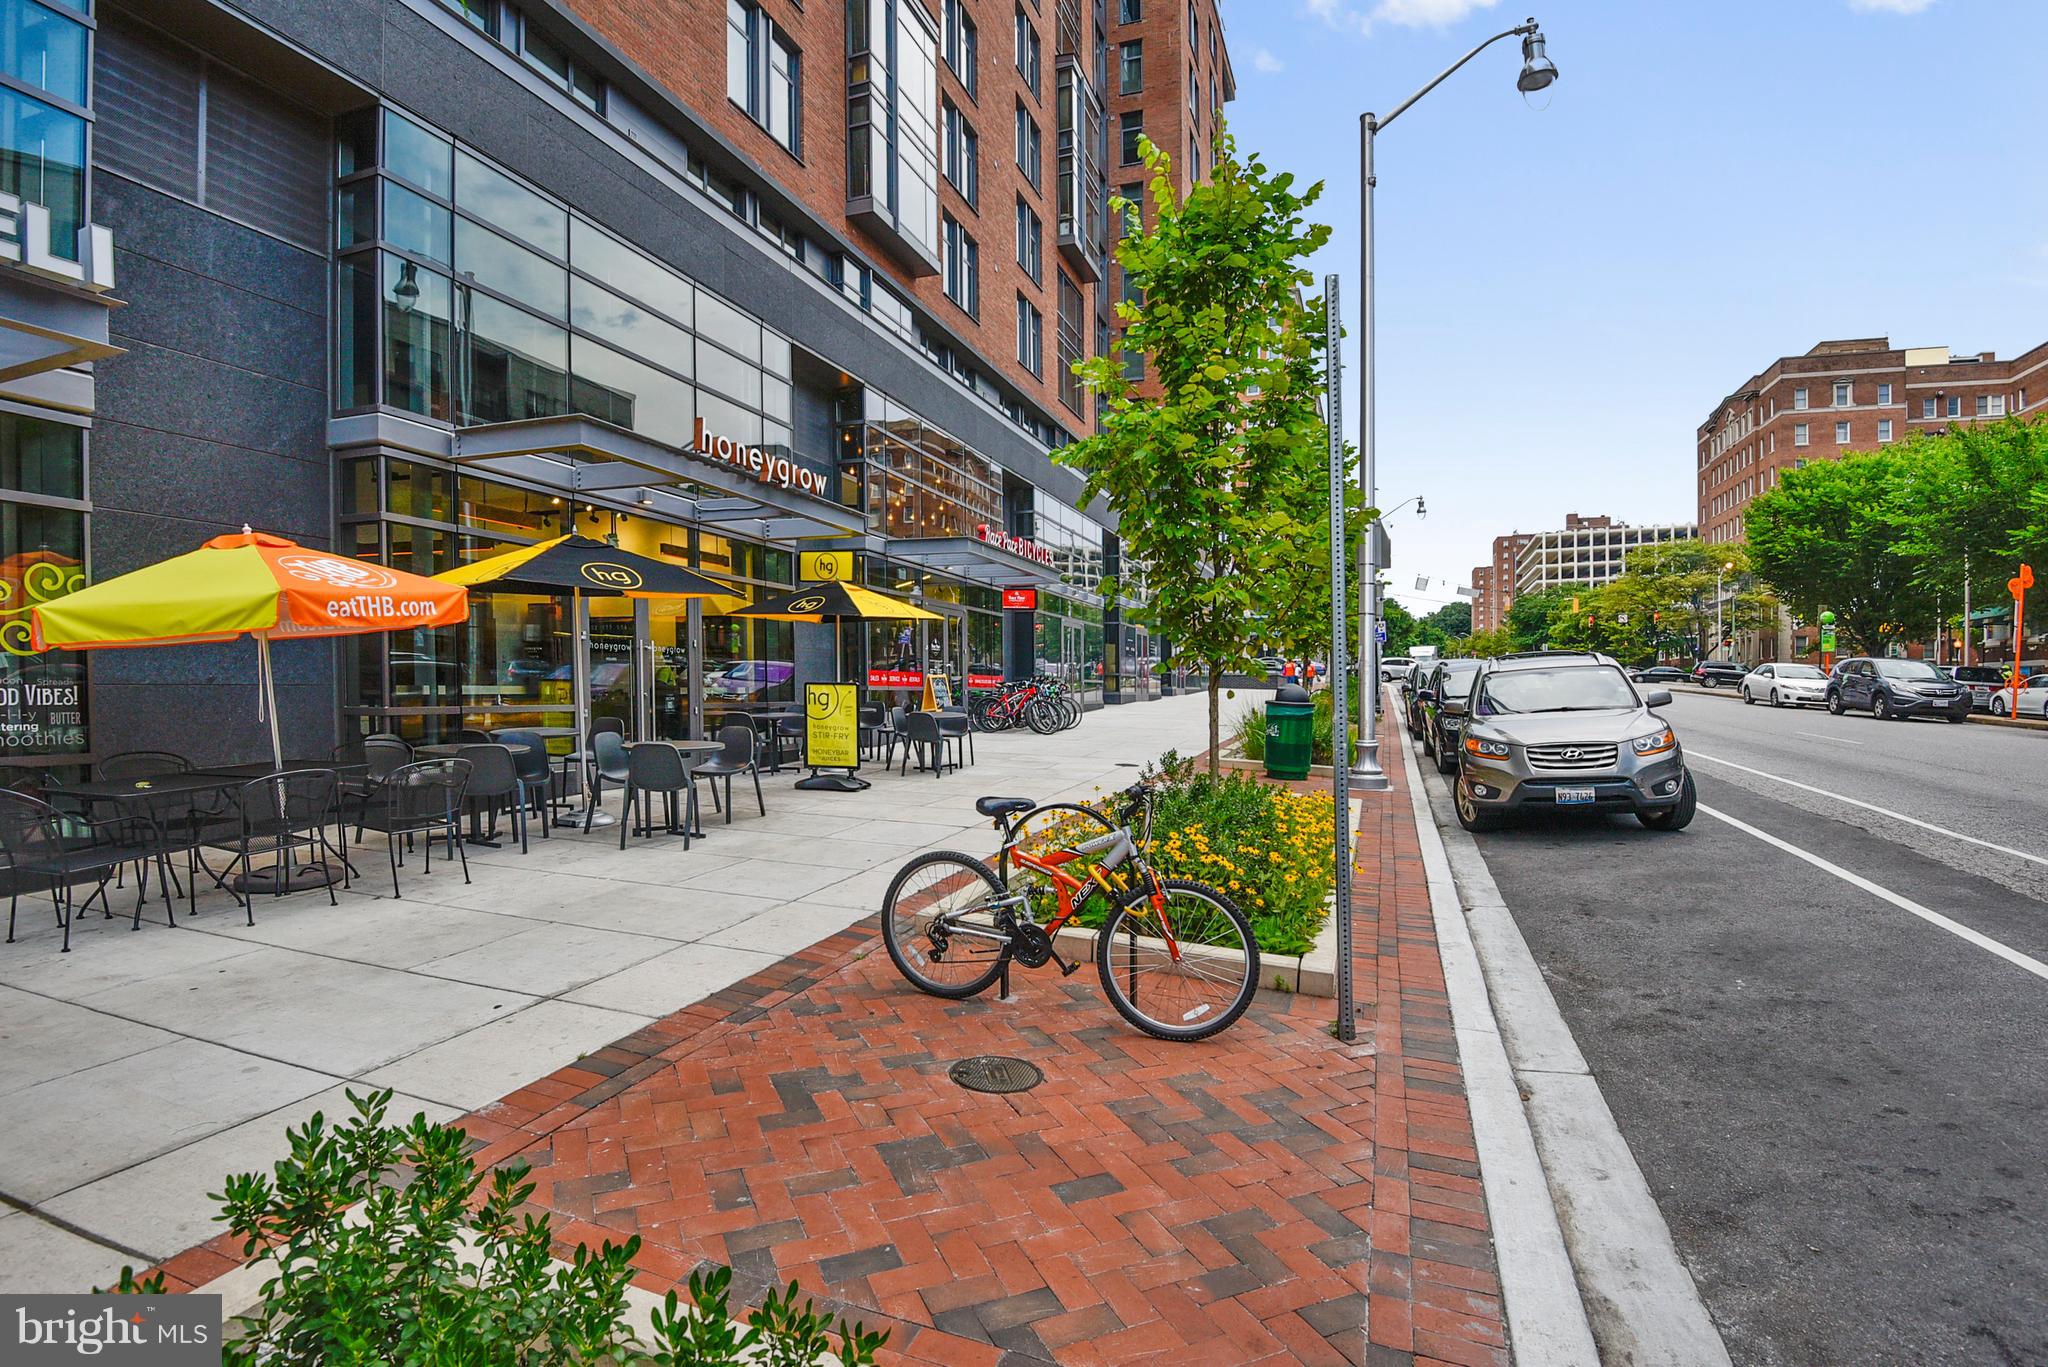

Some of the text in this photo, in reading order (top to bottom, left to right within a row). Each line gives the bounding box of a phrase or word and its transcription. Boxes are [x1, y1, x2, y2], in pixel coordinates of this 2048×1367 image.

[697, 417, 827, 496] honeygrow
[985, 524, 1055, 567] Race Pace BICYCLES
[819, 558, 834, 575] hg
[591, 567, 631, 585] hg
[326, 595, 437, 618] eatTHB.com
[796, 599, 819, 611] hg
[653, 646, 686, 655] oneygrow
[0, 677, 23, 685] con
[24, 684, 78, 706] VIBES!
[808, 685, 830, 711] hg
[50, 711, 81, 725] BUTTER
[1, 722, 39, 732] tering
[812, 748, 850, 756] HONEYBAR
[1070, 866, 1103, 910] NEX
